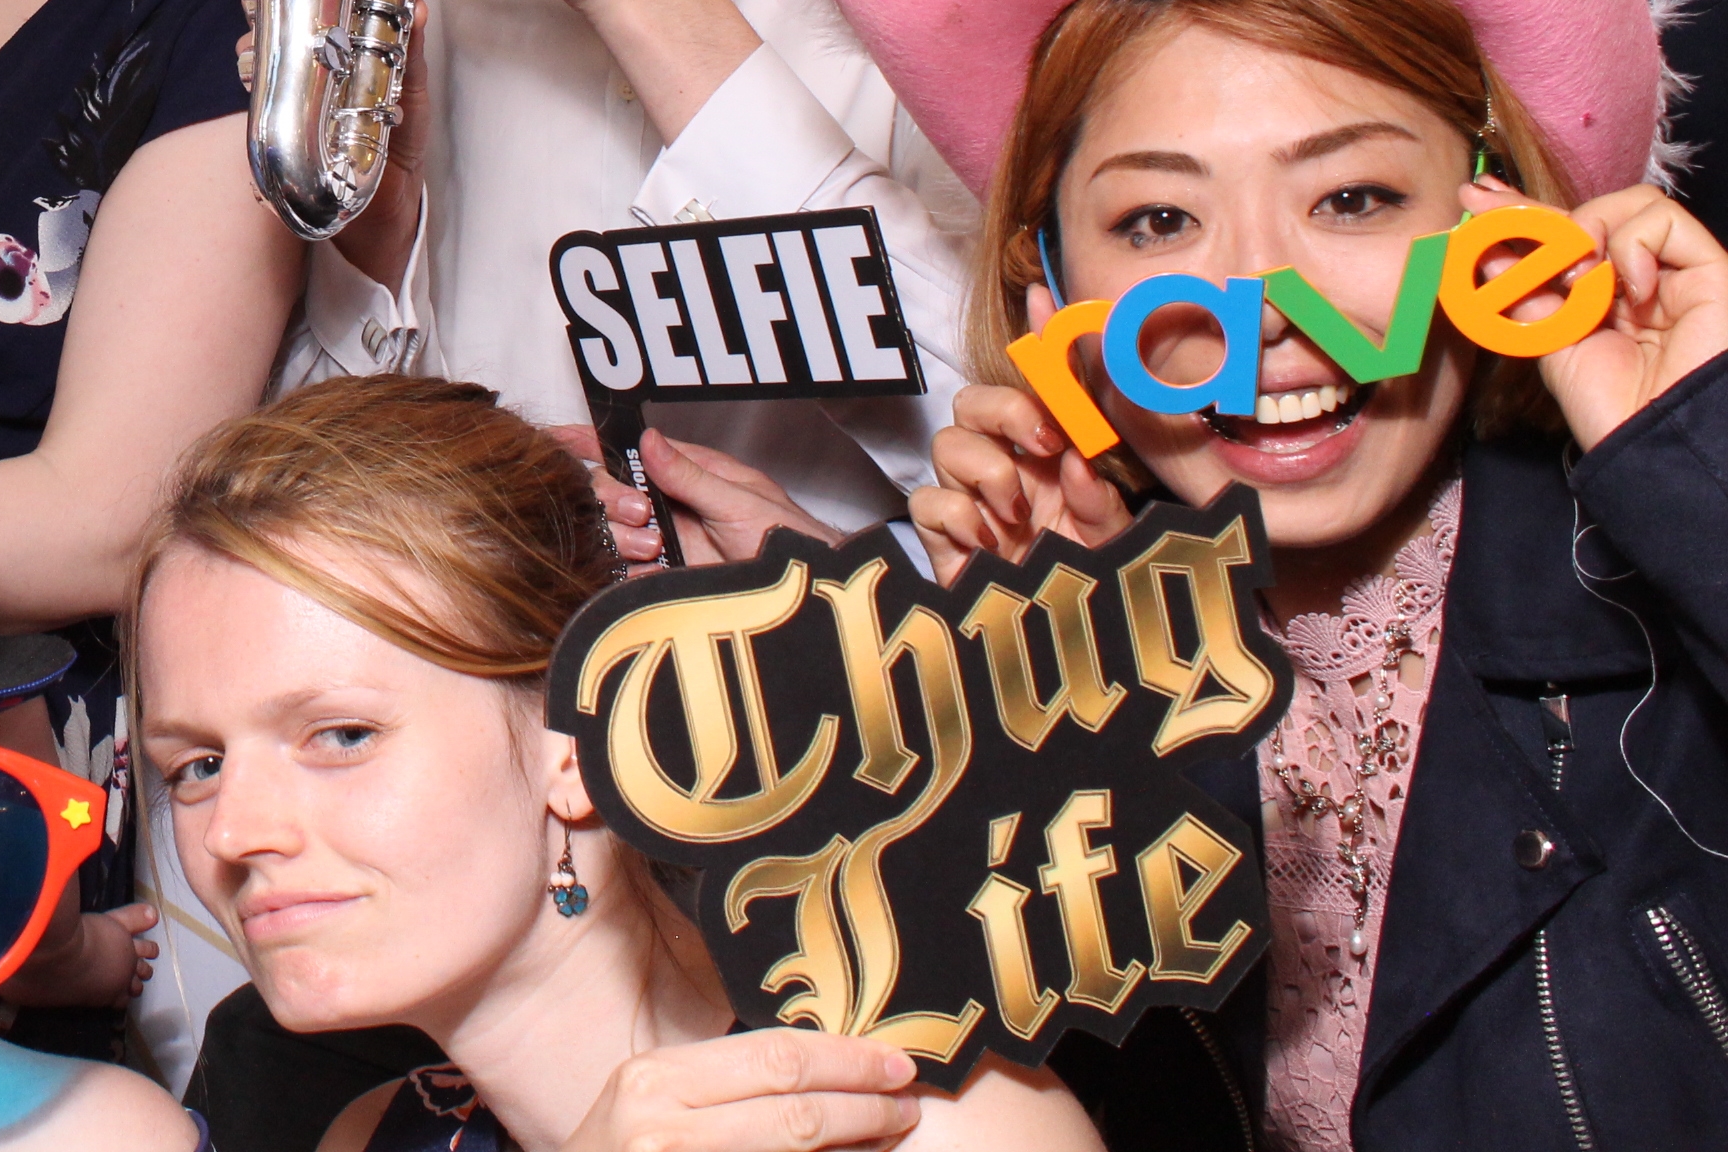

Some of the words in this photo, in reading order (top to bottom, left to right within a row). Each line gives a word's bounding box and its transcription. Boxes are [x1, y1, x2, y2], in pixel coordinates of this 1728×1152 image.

[559, 224, 908, 391] SELFIE
[1005, 204, 1615, 459] rave
[576, 514, 1273, 843] Thug
[724, 788, 1252, 1064] Life
